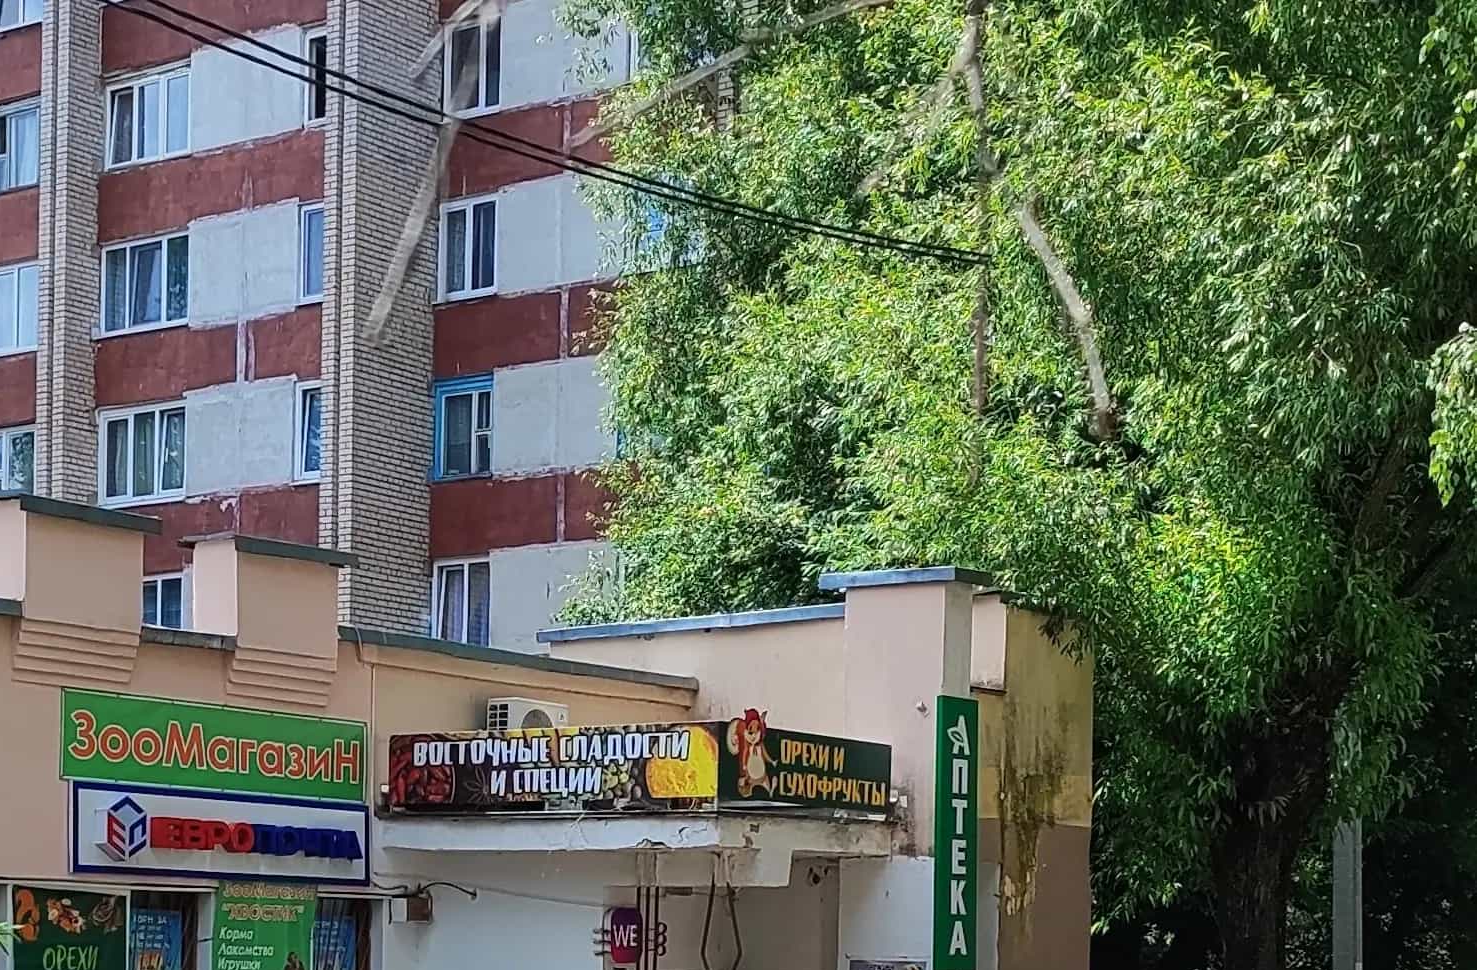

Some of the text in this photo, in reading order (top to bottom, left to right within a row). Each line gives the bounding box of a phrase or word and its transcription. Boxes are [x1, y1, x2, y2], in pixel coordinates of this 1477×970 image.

[413, 731, 690, 767] ВОСТОЧНЫЕ СЛАДОСТИ
[780, 738, 845, 774] ОРЕХИ И
[490, 766, 603, 797] И СПЕЦИИ
[779, 771, 886, 806] СУХОФРУКТЫ
[946, 714, 971, 957] АПТЕКА
[218, 942, 274, 957] Лакомства
[219, 926, 254, 942] Корма
